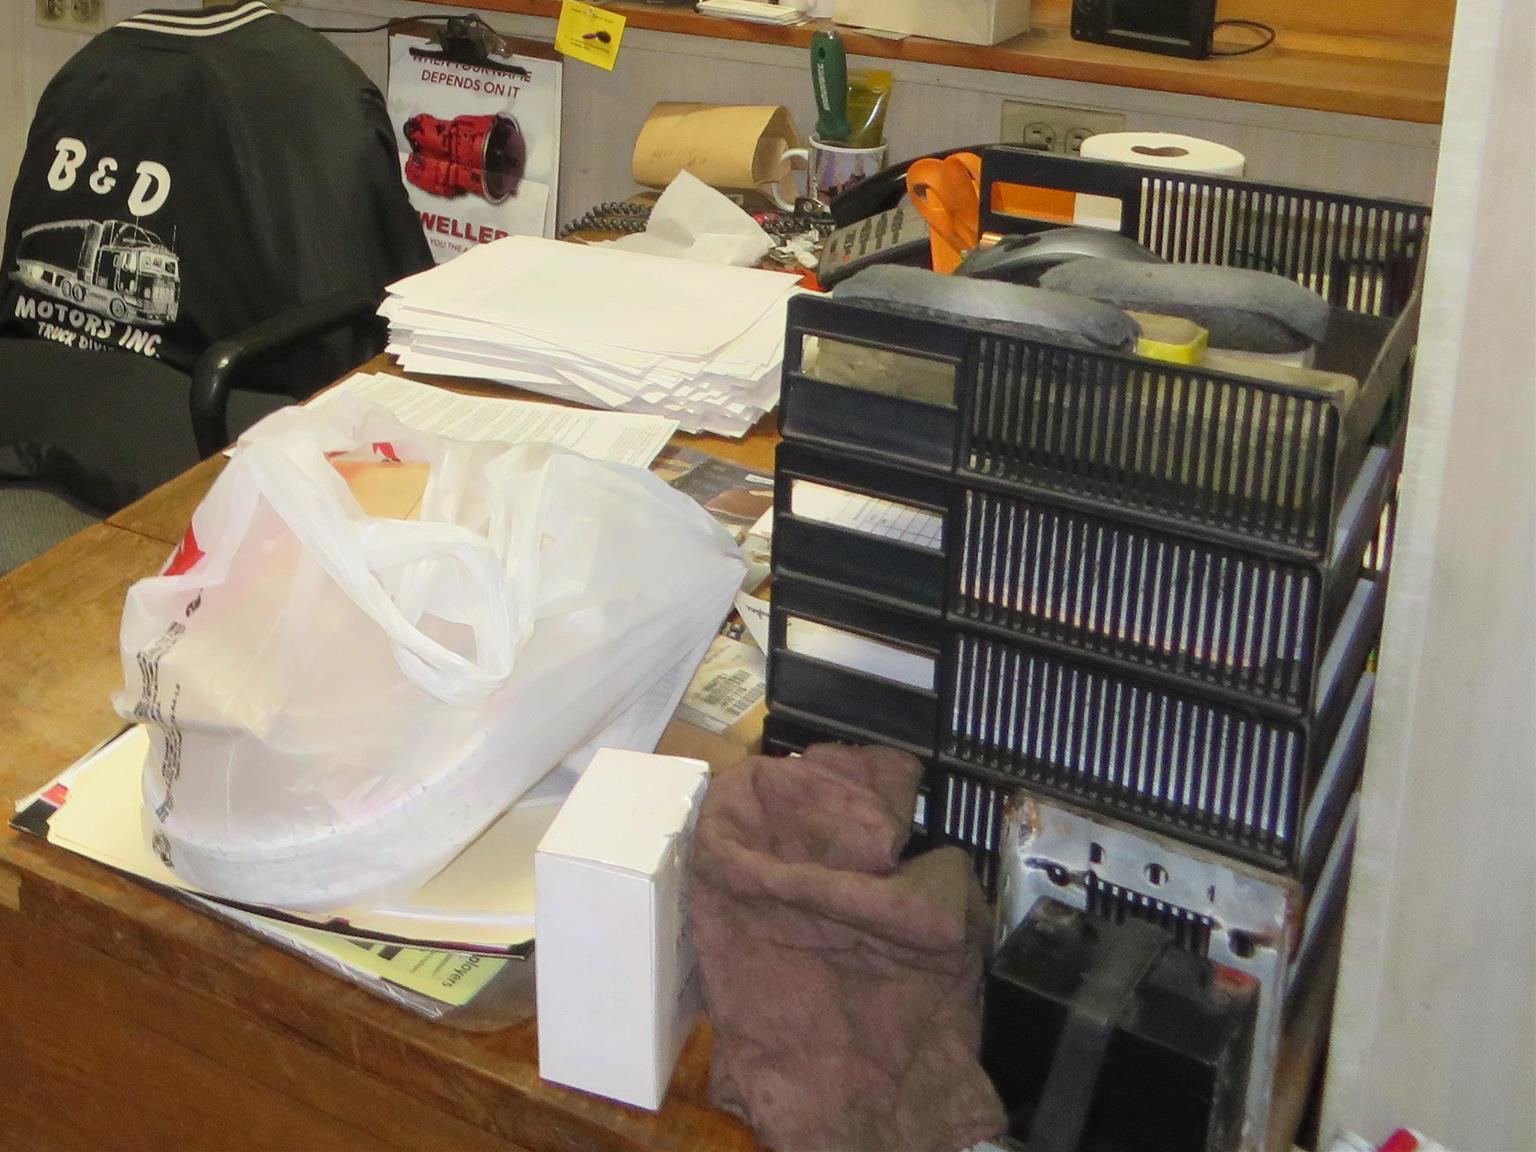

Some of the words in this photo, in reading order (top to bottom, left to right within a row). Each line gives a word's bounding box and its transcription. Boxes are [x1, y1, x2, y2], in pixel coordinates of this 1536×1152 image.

[421, 71, 480, 92] DEPENDS
[484, 81, 505, 96] ON
[507, 86, 520, 98] IT
[47, 137, 87, 192] B
[89, 156, 119, 195] &
[127, 160, 171, 217] D
[15, 295, 115, 339] MOTORS
[118, 325, 161, 358] INC.
[38, 321, 77, 347] TRUCK
[441, 953, 481, 989] ployers
